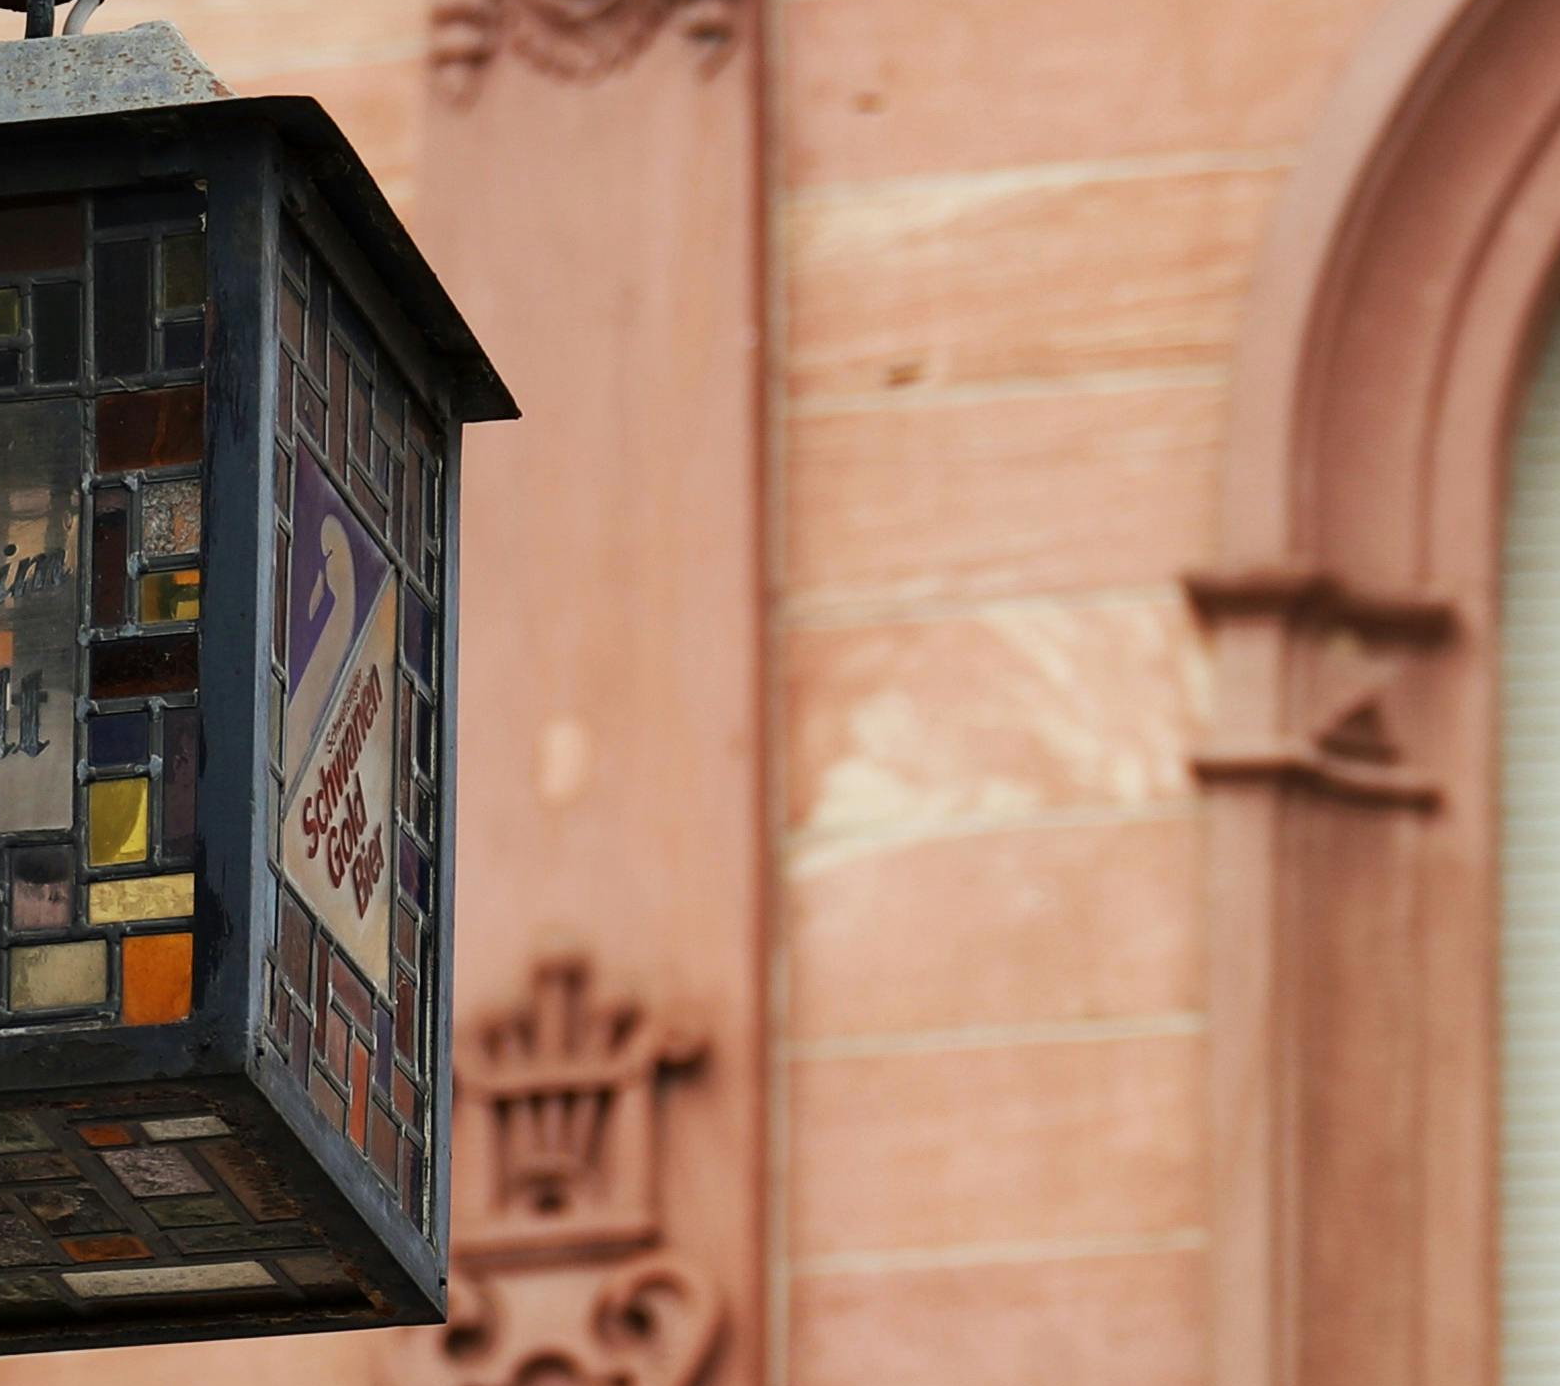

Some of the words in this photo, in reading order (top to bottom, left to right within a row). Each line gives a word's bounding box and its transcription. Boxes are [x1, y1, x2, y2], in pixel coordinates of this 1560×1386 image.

[302, 663, 384, 860] Schwanen
[326, 770, 369, 890] Gold
[351, 821, 386, 921] Bier
